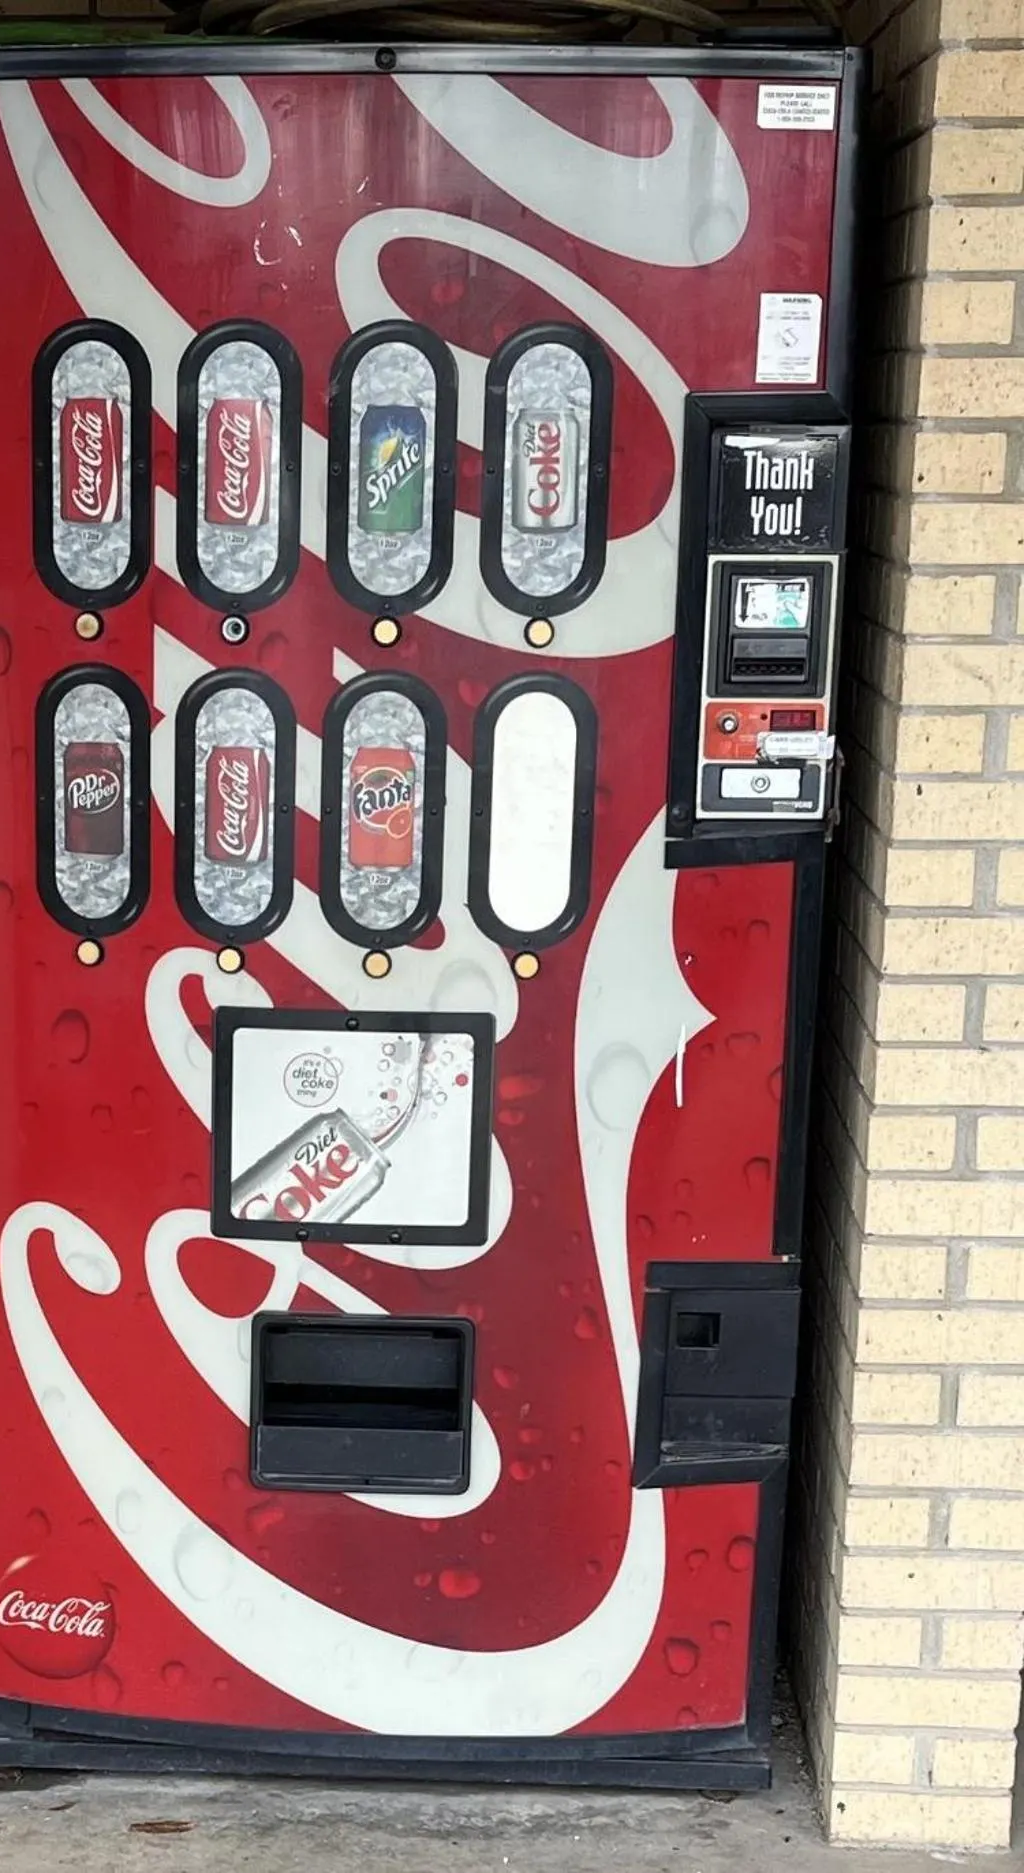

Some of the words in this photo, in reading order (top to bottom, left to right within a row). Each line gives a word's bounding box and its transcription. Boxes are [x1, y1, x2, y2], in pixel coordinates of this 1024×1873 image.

[71, 407, 103, 517] Coca-Cola
[217, 407, 251, 519] Coca-Cola
[366, 443, 420, 509] Sprite
[528, 422, 561, 518] Coke
[743, 450, 815, 490] Thank
[750, 496, 803, 536] You!
[68, 777, 118, 809] Pepper
[85, 773, 106, 791] Dr
[353, 776, 412, 821] Fanta
[216, 756, 250, 856] Coca-Cola
[292, 1067, 318, 1079] diet
[300, 1077, 334, 1089] coke
[295, 1128, 337, 1165] Diet
